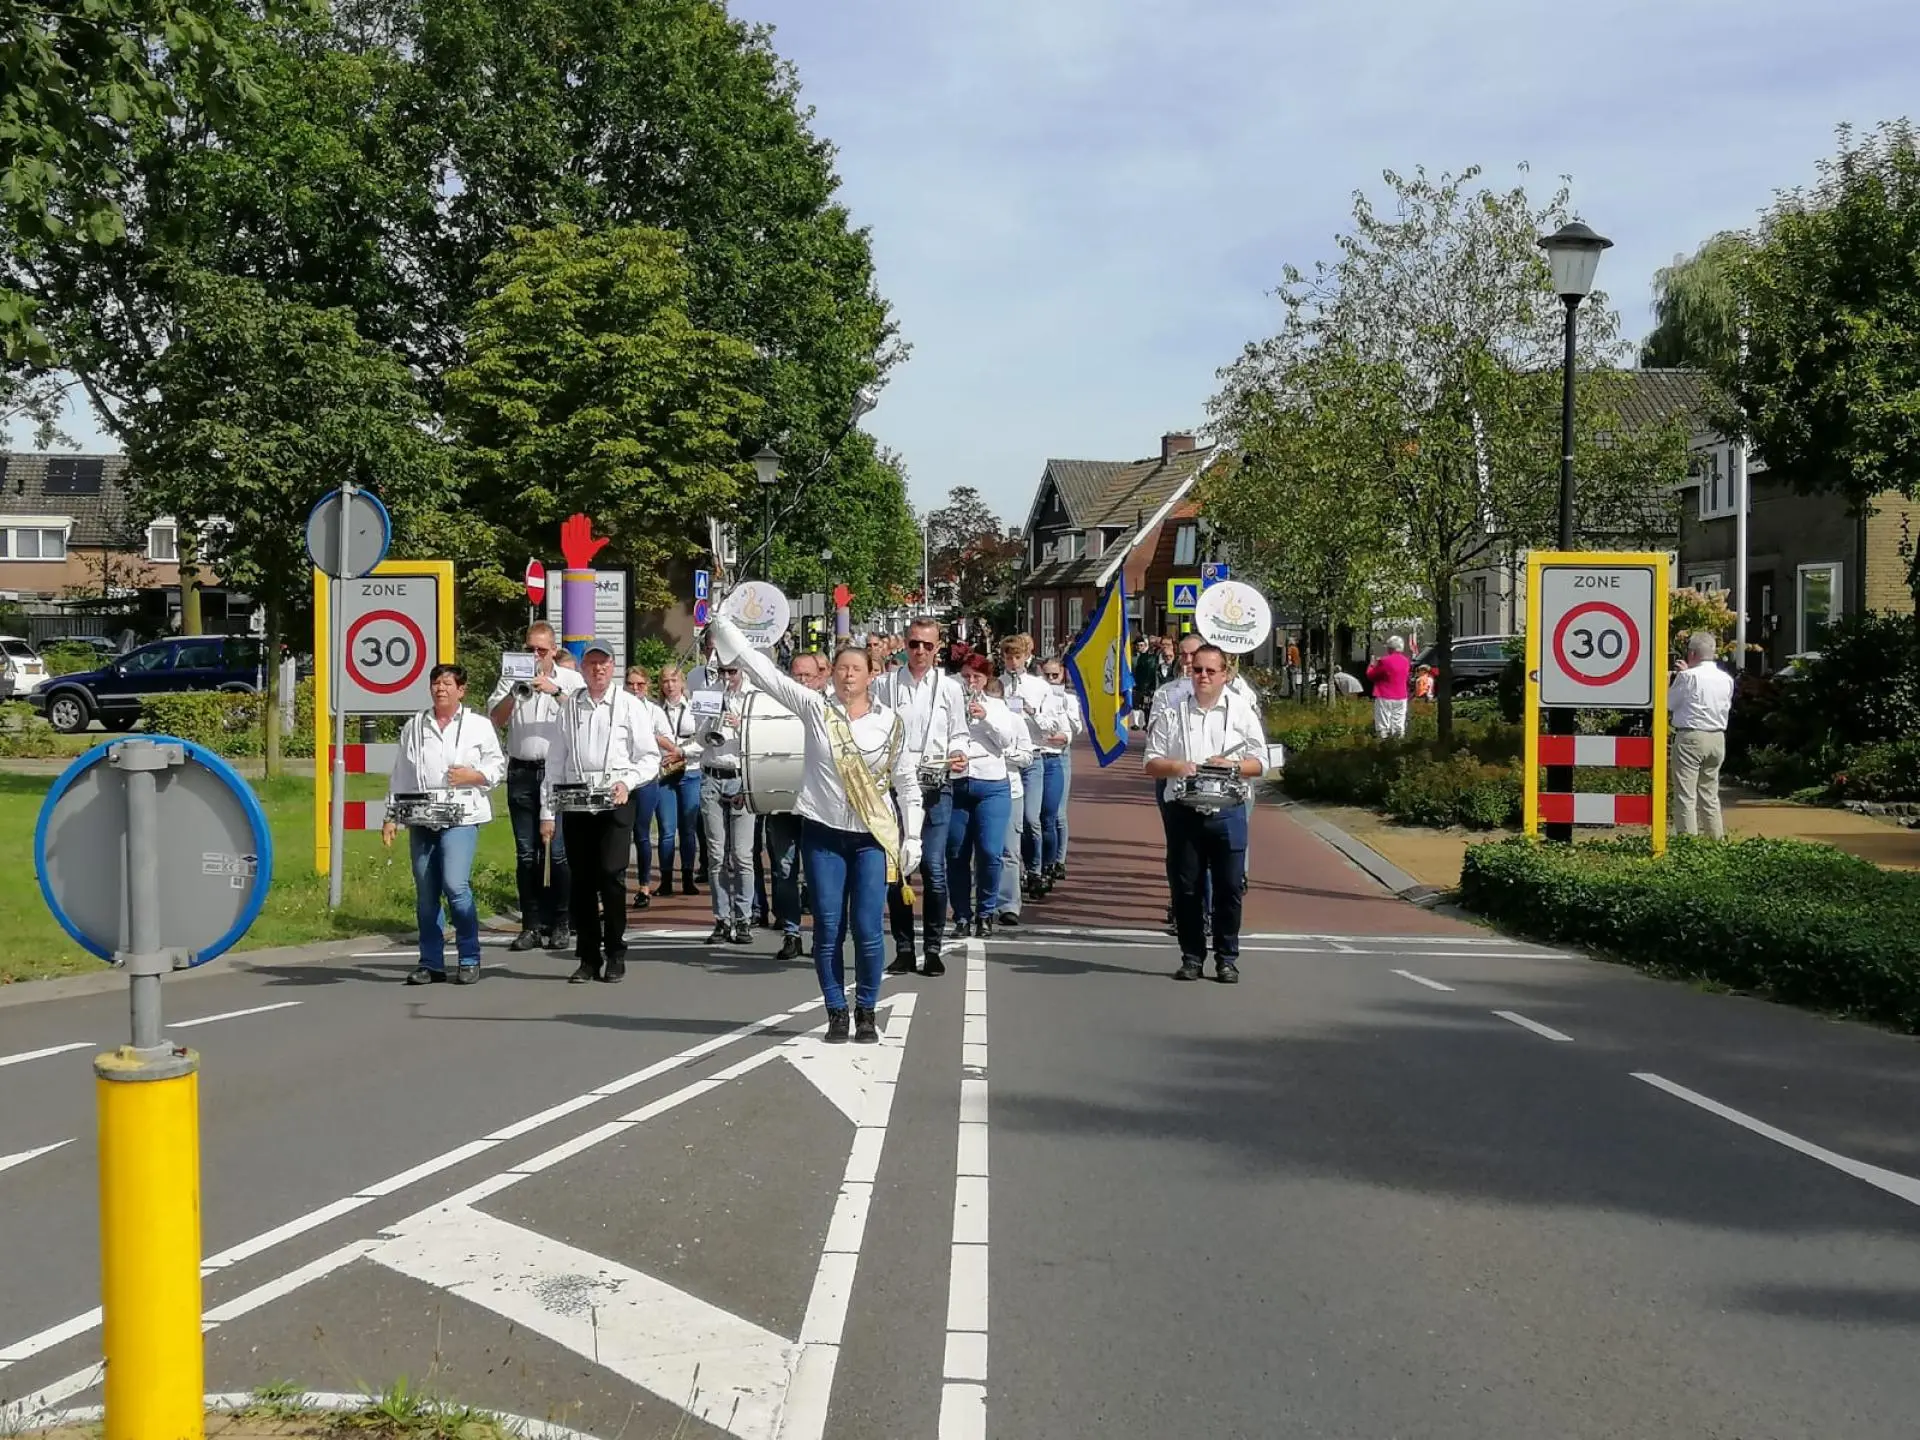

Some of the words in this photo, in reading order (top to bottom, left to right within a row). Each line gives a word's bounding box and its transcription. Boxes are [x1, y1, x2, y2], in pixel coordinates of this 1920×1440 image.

[1573, 575, 1621, 589] ZONE
[361, 584, 407, 596] ZONE
[1209, 633, 1256, 647] AMICITIA
[1570, 628, 1623, 660] 30
[359, 636, 411, 667] 30
